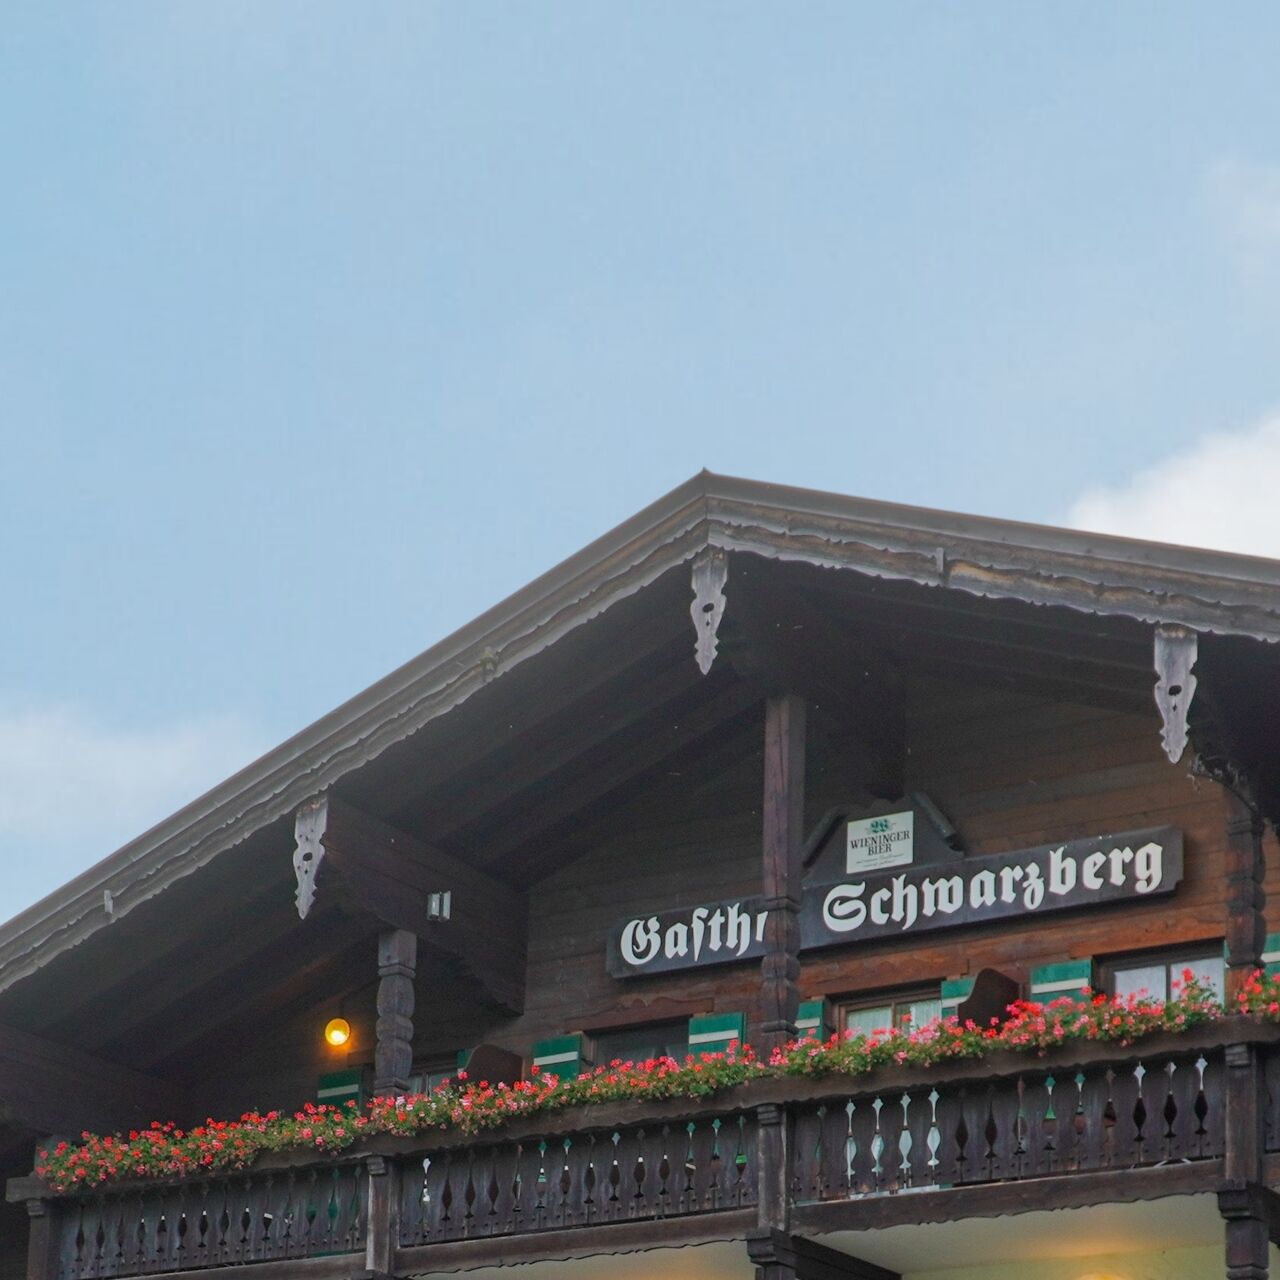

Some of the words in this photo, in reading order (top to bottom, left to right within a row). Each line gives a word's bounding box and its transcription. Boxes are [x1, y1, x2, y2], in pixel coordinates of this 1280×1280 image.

[850, 830, 910, 849] WIENINGER
[868, 844, 892, 856] BIER
[823, 842, 1163, 932] Schwarzberg
